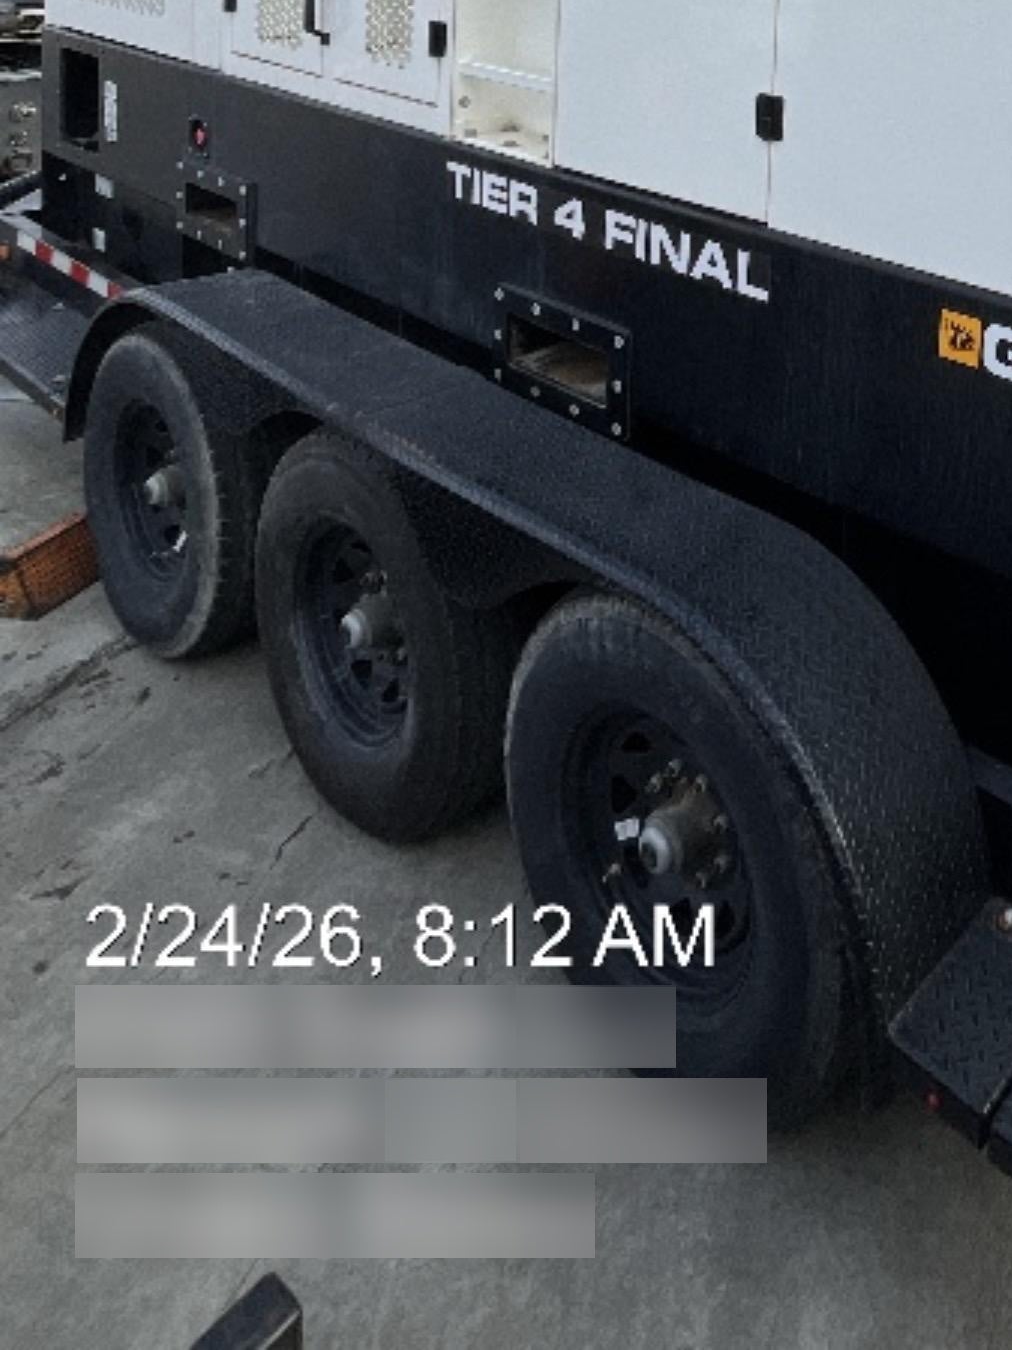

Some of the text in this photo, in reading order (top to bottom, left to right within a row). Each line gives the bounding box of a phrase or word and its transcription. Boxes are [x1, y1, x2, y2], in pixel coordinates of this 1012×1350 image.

[445, 160, 769, 304] TIER 4 FINAL
